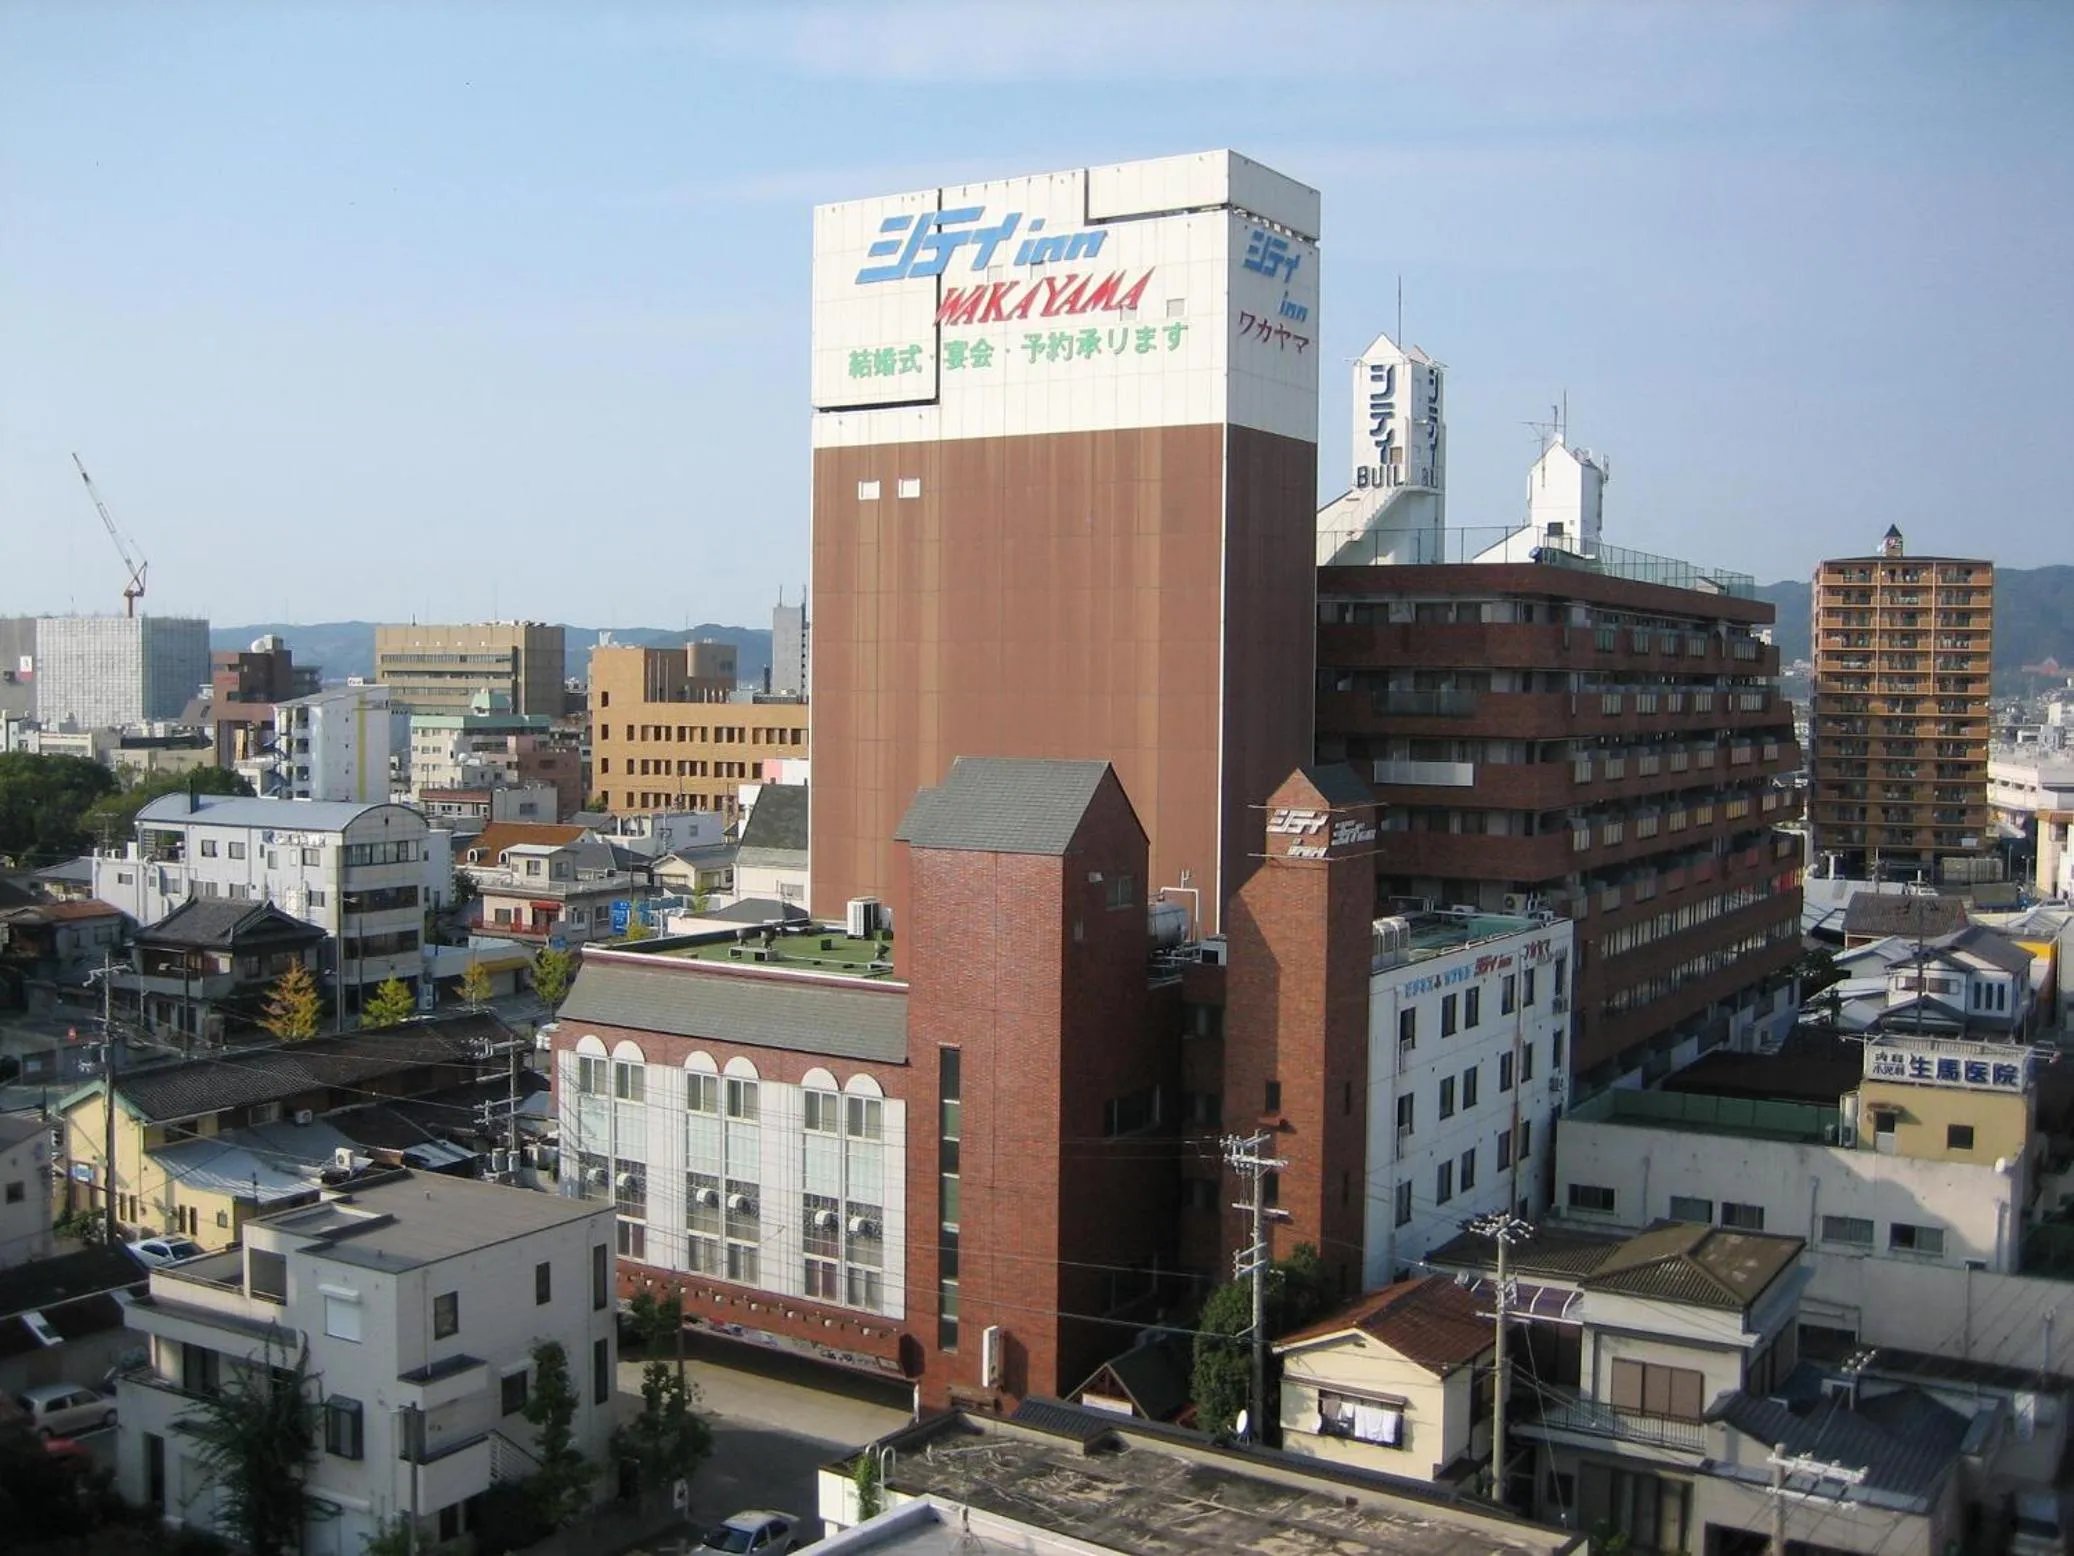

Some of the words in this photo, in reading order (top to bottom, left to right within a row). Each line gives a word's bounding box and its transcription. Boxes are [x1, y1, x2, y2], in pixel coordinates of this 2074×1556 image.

[1013, 217, 1109, 267] inn
[933, 266, 1156, 328] WAKAYAMA
[1238, 310, 1310, 354] ワカヤマ
